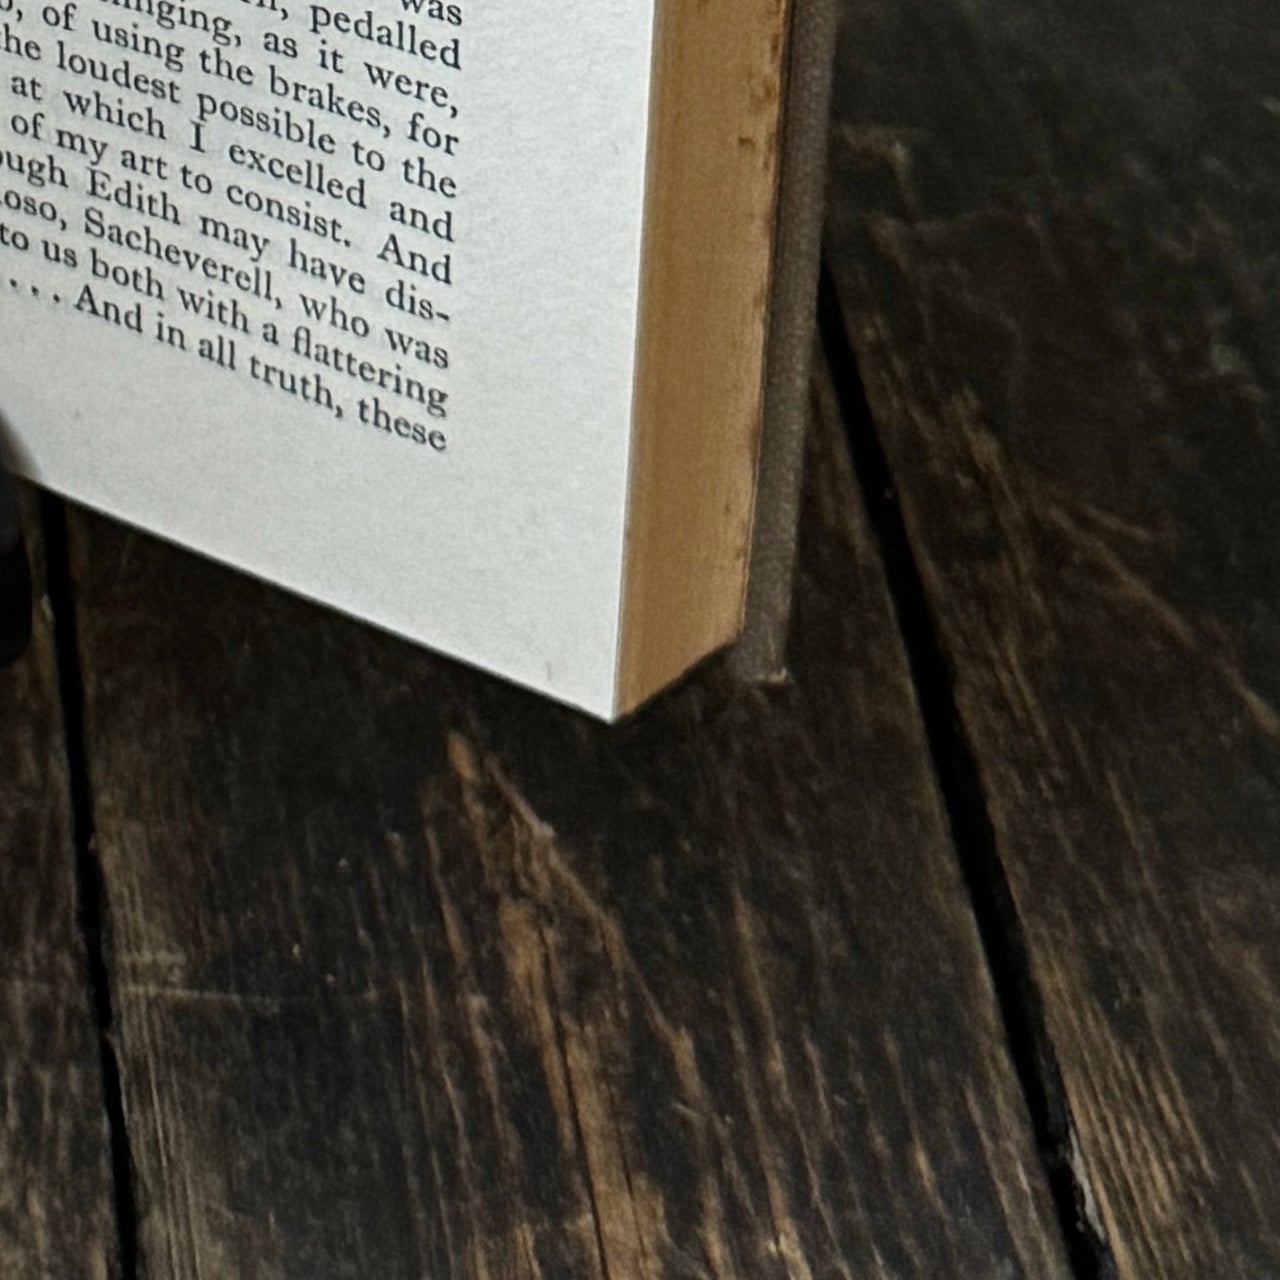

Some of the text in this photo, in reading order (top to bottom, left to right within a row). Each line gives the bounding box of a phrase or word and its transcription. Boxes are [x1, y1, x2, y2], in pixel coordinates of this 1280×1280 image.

[263, 32, 299, 59] as
[318, 48, 345, 75] it
[363, 61, 458, 119] were,
[84, 206, 283, 310] Sacheverell,
[299, 293, 370, 338] who
[384, 328, 449, 370] was
